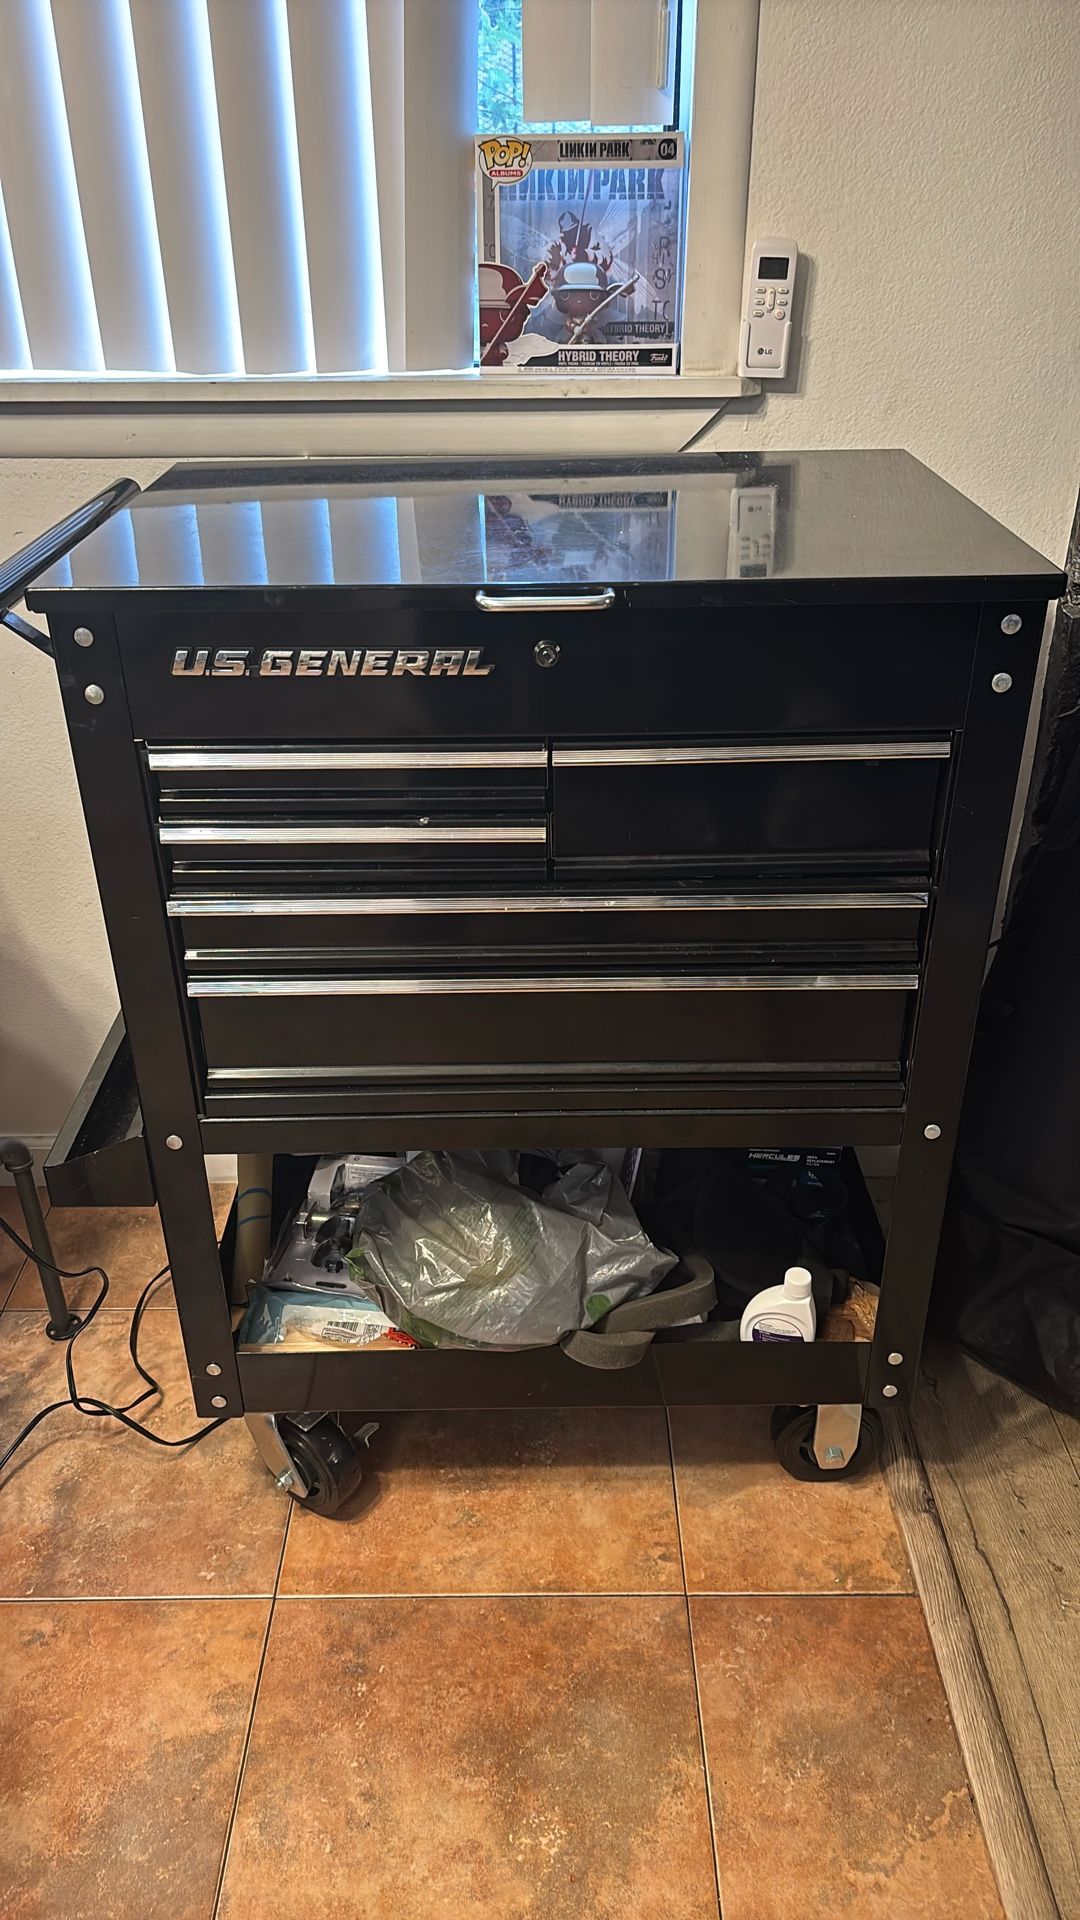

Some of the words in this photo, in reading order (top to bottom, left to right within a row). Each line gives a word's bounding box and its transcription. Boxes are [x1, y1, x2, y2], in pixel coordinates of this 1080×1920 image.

[479, 139, 532, 170] POP!
[559, 142, 597, 158] LINKIN
[600, 142, 630, 158] PARK
[660, 143, 675, 156] 04
[593, 168, 665, 200] PARK
[558, 350, 597, 362] HYBRID
[599, 350, 640, 362] THEORY
[171, 650, 250, 676] U.S.
[259, 650, 496, 676] GENERAL
[748, 1152, 800, 1162] HERCULES
